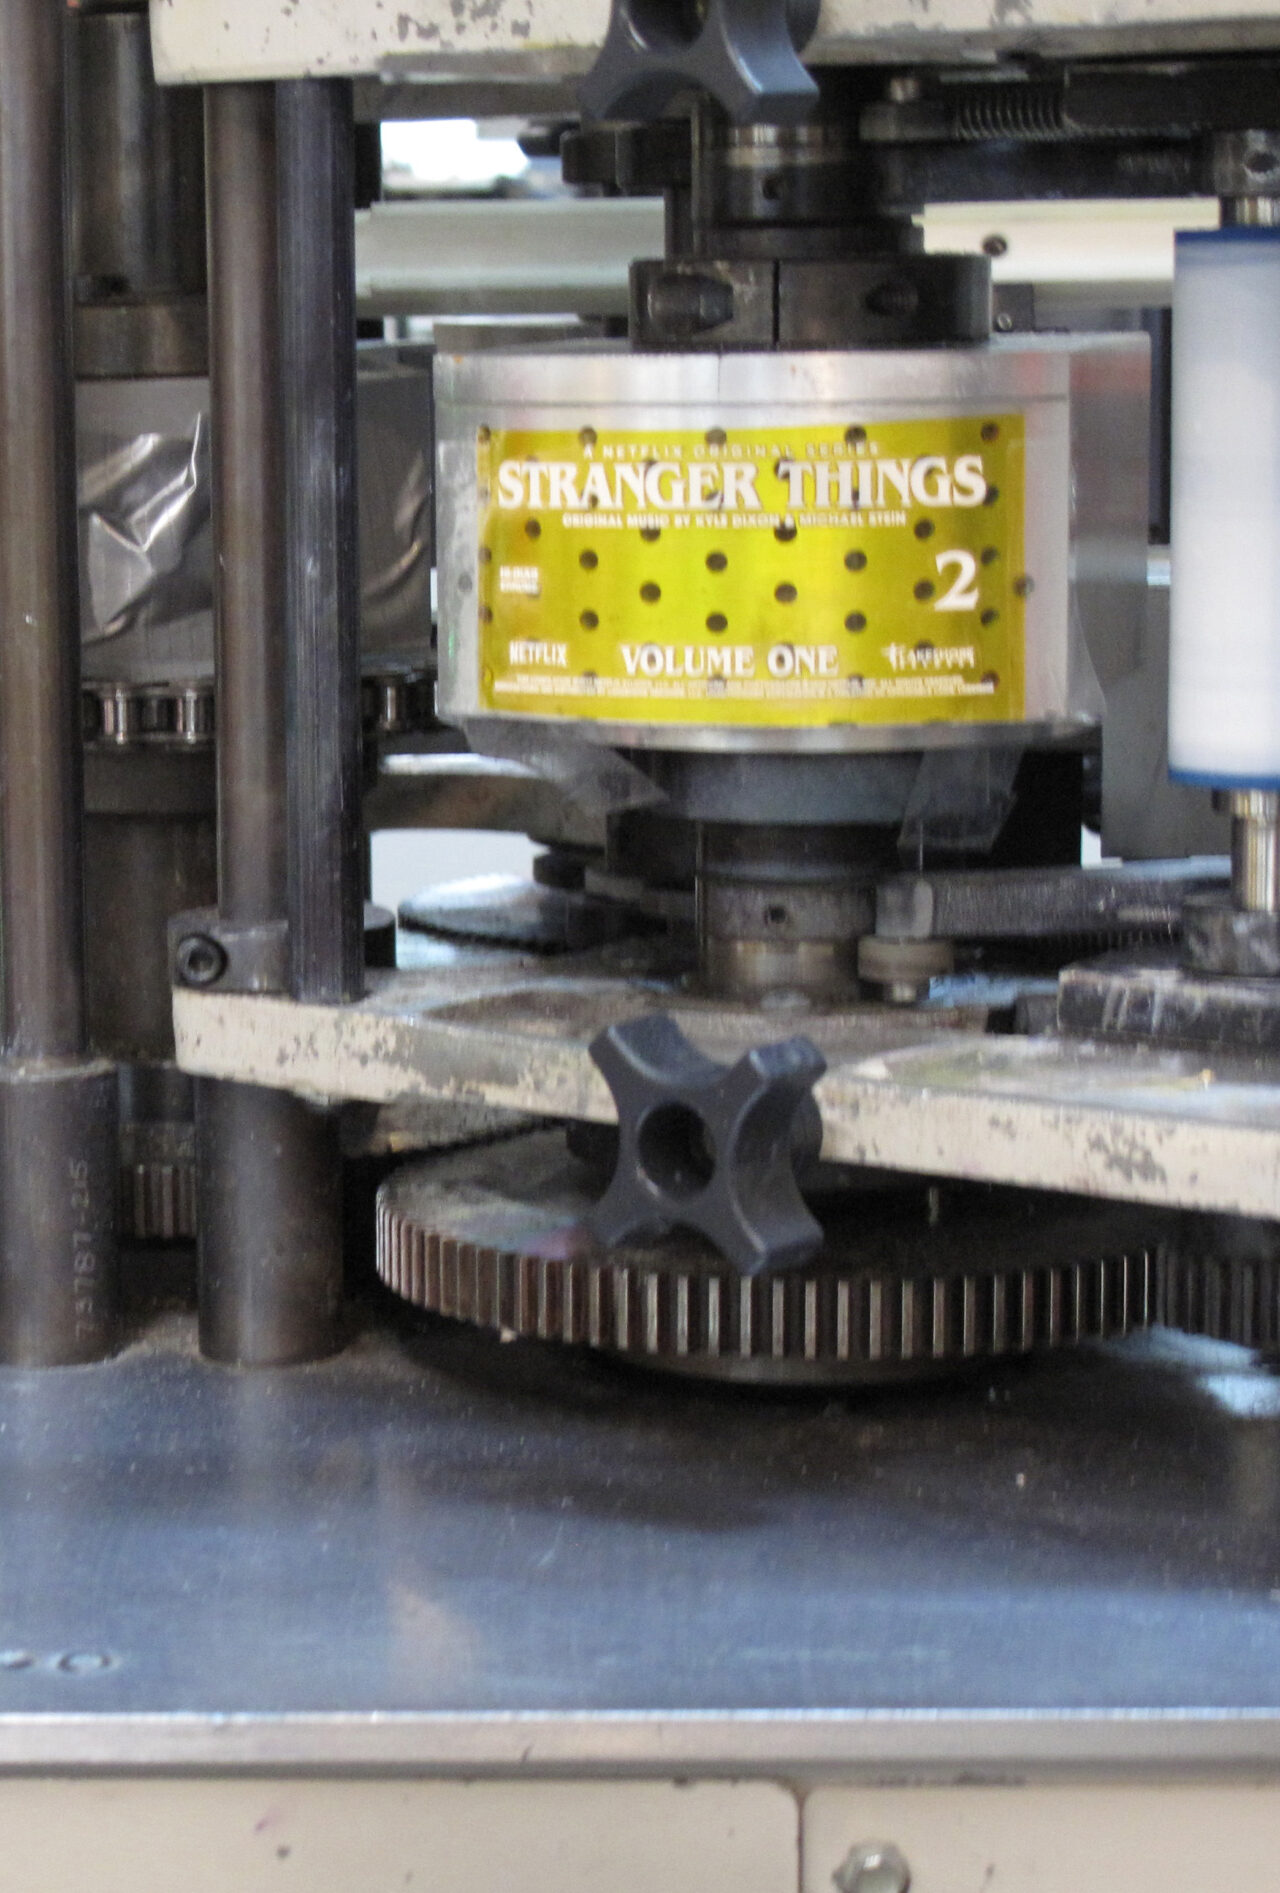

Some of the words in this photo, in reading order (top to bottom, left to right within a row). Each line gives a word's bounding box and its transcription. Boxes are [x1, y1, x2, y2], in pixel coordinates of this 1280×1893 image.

[603, 443, 683, 459] NETFLIX
[497, 459, 762, 510] STRANGER
[778, 455, 988, 509] THINGS
[934, 549, 980, 612] 2
[509, 640, 568, 667] NETFLIX
[621, 644, 754, 677] VOLUME
[767, 643, 838, 676] ONE
